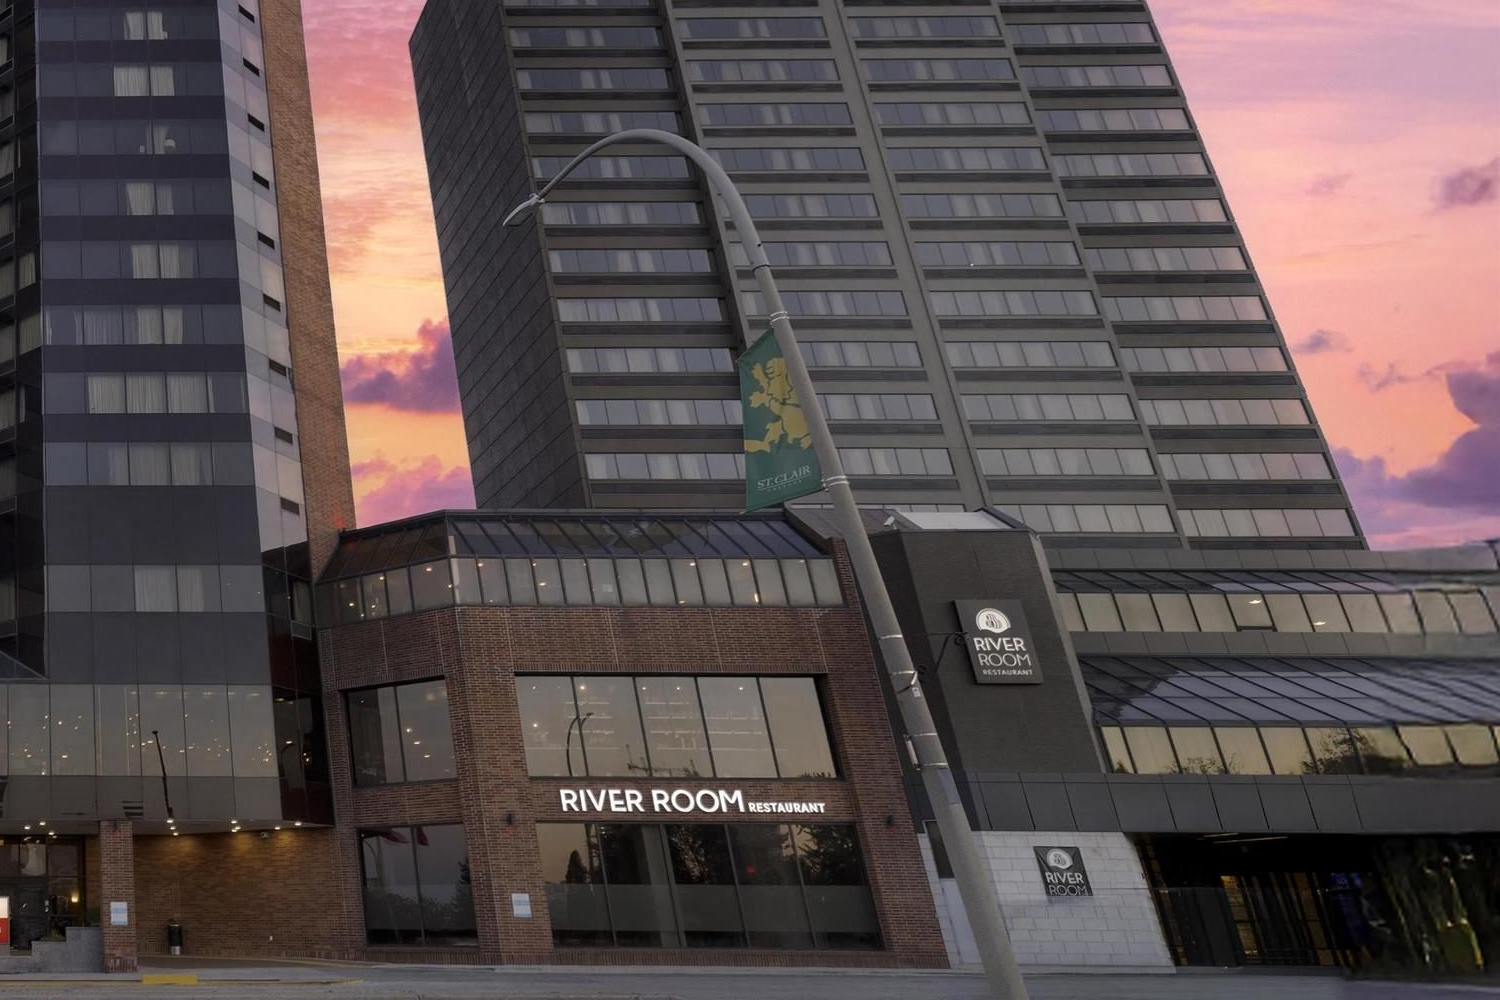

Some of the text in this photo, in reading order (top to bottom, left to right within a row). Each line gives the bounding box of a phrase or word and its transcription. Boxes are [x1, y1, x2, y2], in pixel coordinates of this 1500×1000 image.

[973, 637, 1027, 652] RIVER
[978, 653, 1032, 667] ROOM
[559, 789, 826, 814] RIVER ROOM RESTAURANT
[1045, 871, 1084, 884] RIVER
[1048, 884, 1088, 896] ROOM
